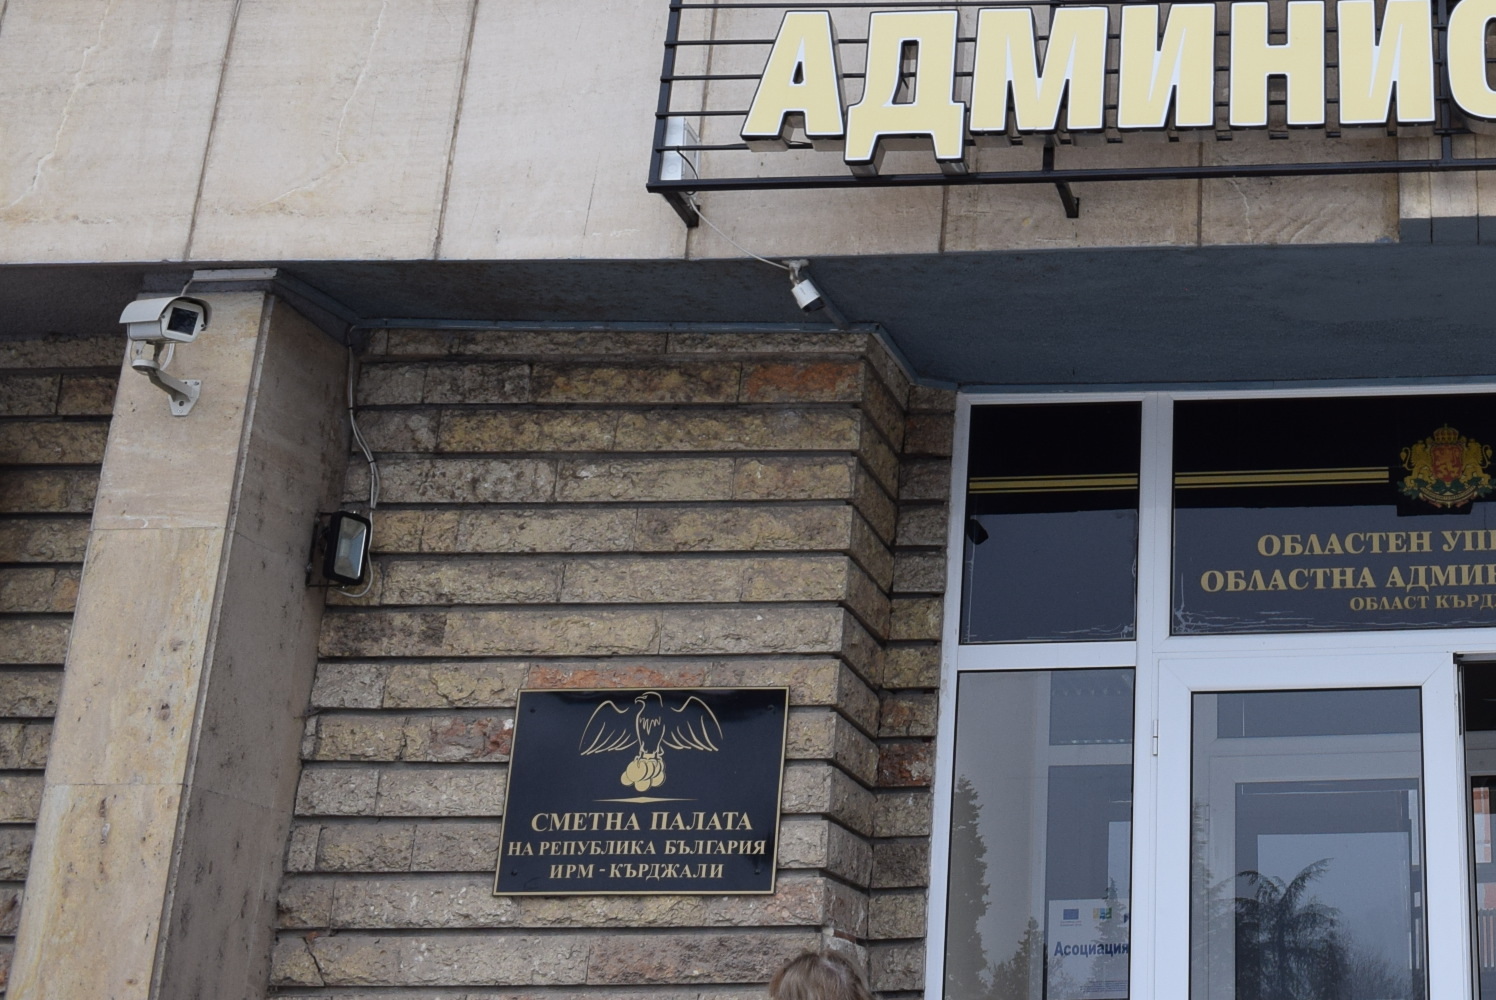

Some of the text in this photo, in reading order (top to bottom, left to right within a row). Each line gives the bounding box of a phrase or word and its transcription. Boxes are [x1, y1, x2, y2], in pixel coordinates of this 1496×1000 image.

[1257, 531, 1432, 557] ОБЛАСТЕН
[1200, 566, 1376, 593] ОБЛАСТНА
[1349, 596, 1430, 611] ОБЛАСТ
[531, 812, 753, 832] СМЕТНА ПАЛАТА
[508, 840, 767, 856] НА РЕПУБЛИКА БЪЛГАРИЯ
[549, 864, 594, 879] ИРМ
[609, 863, 724, 881] КЪРДЖАЛИ
[1053, 941, 1129, 957] Асоциация
